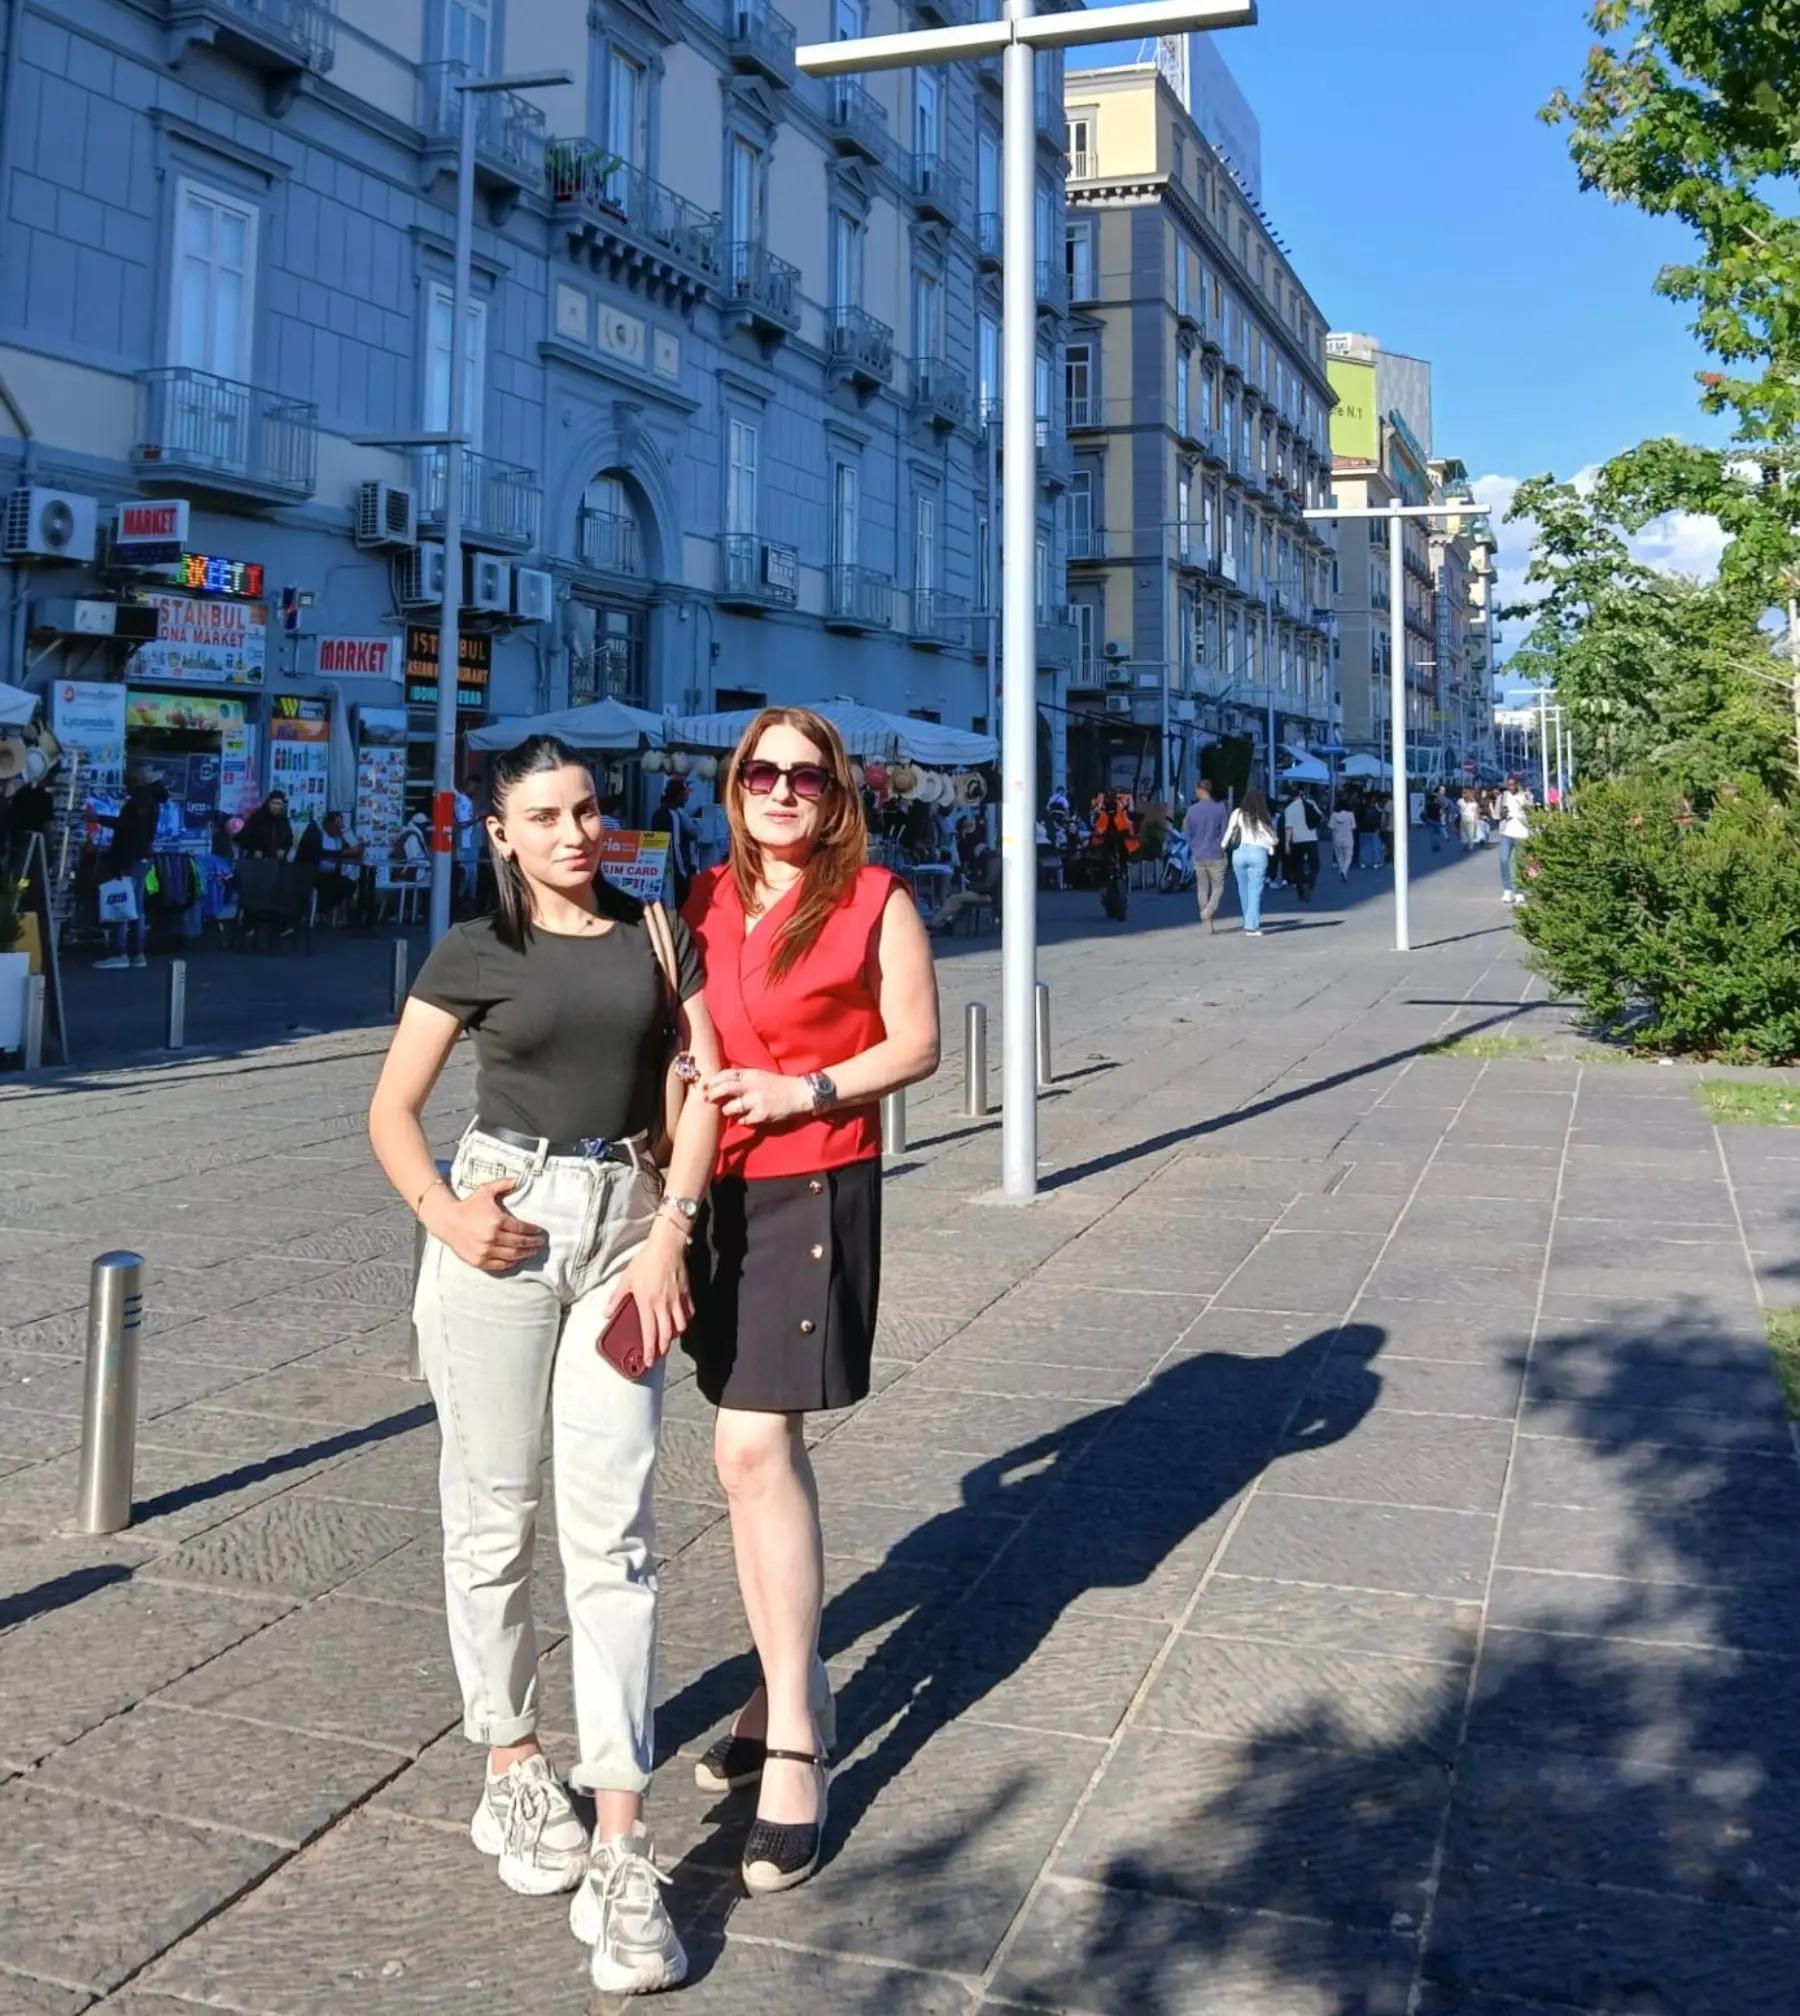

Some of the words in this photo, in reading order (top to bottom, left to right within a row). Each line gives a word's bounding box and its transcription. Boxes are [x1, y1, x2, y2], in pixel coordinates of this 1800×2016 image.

[122, 507, 177, 536] MARKET
[193, 629, 246, 648] MARKET
[412, 630, 487, 660] ISTBUL
[321, 640, 387, 672] MARKET
[458, 689, 482, 705] EBAB
[602, 864, 624, 875] SIM
[627, 866, 658, 876] CARD
